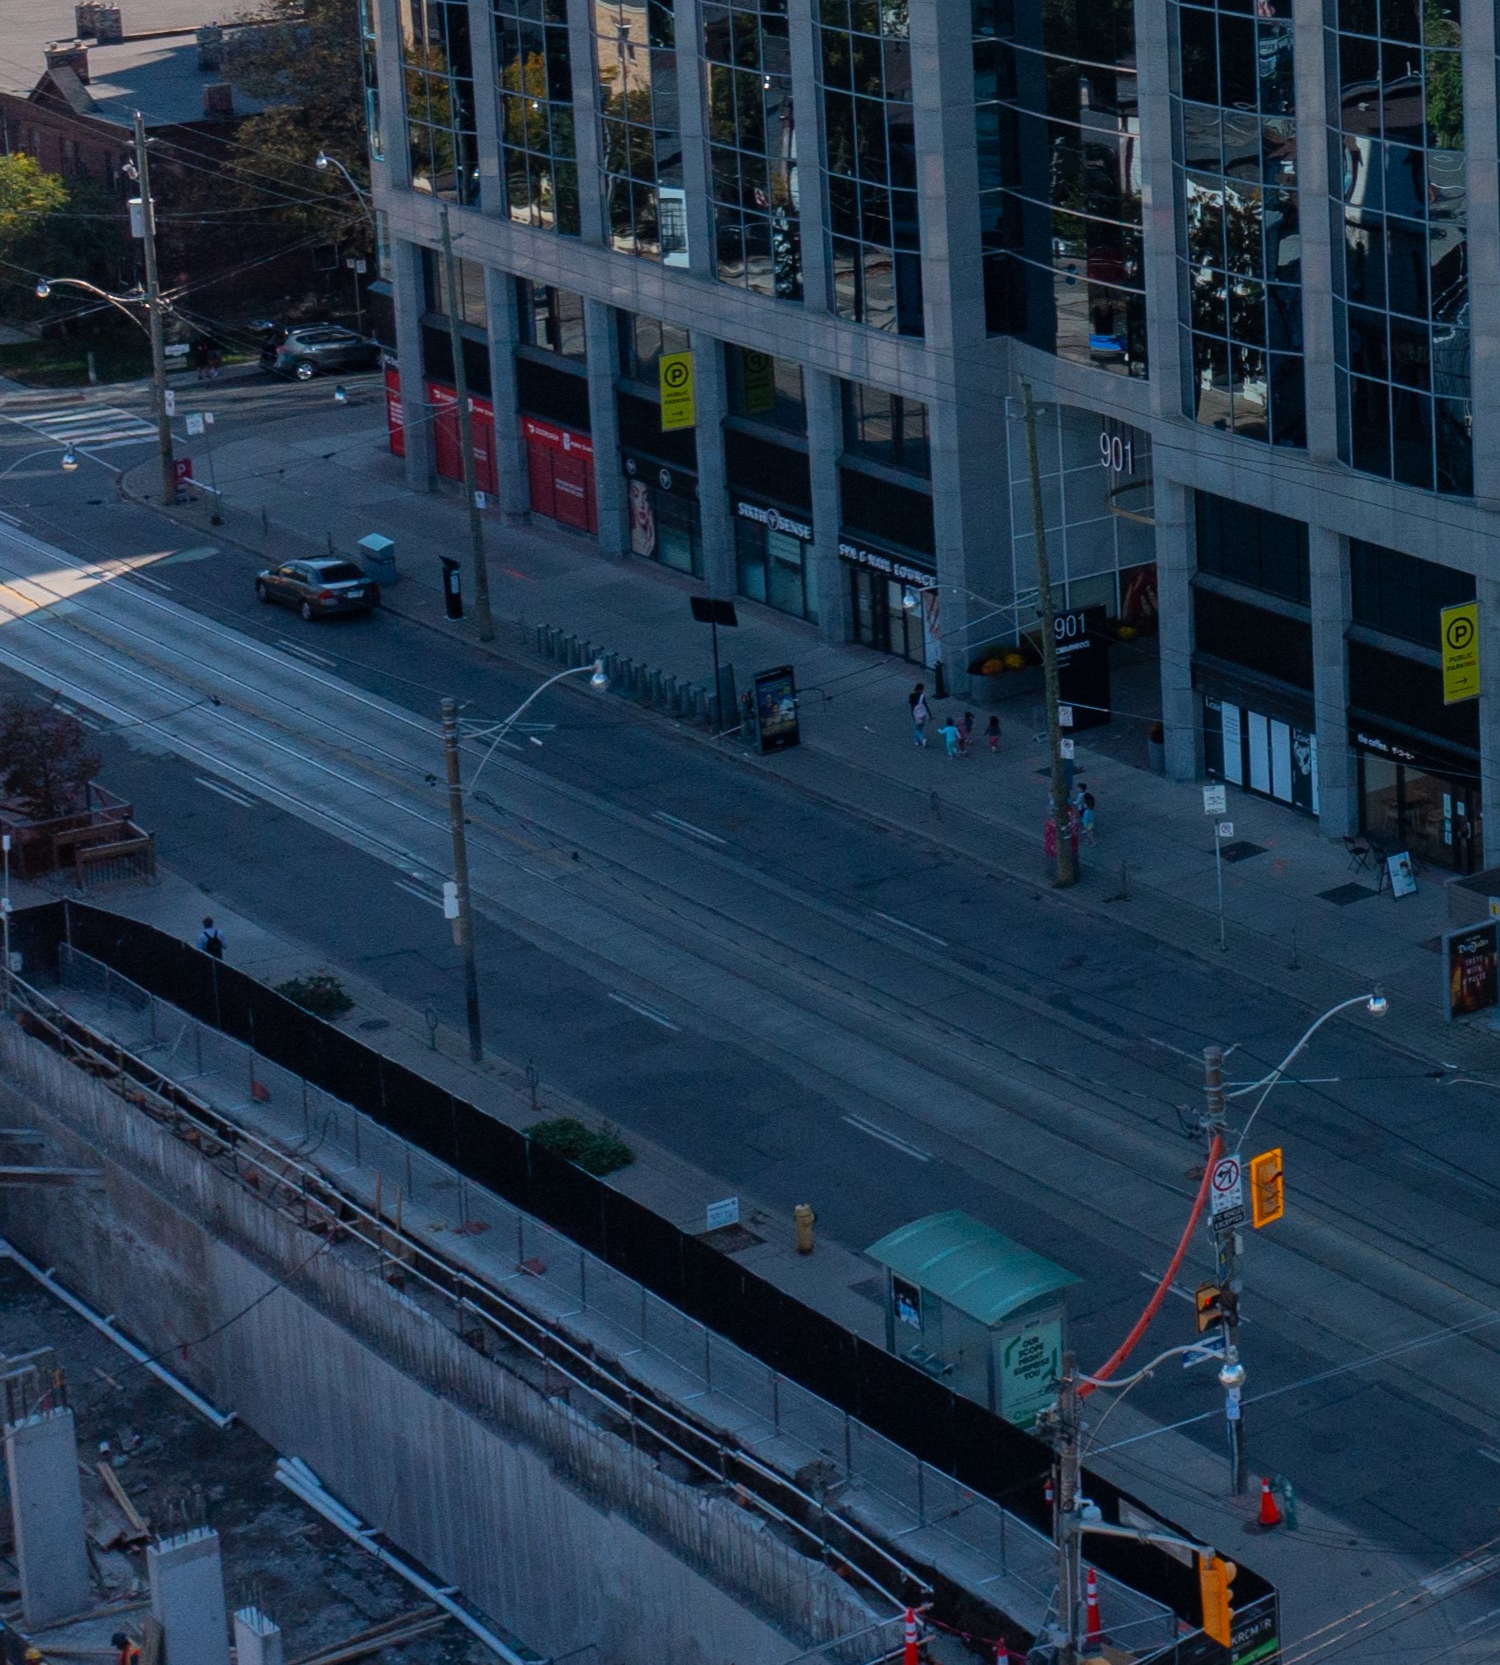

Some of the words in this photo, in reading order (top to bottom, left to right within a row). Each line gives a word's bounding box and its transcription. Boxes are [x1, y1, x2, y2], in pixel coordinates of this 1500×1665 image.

[1100, 432, 1132, 475] 901
[778, 516, 812, 539] SENSE
[1055, 613, 1086, 640] 901
